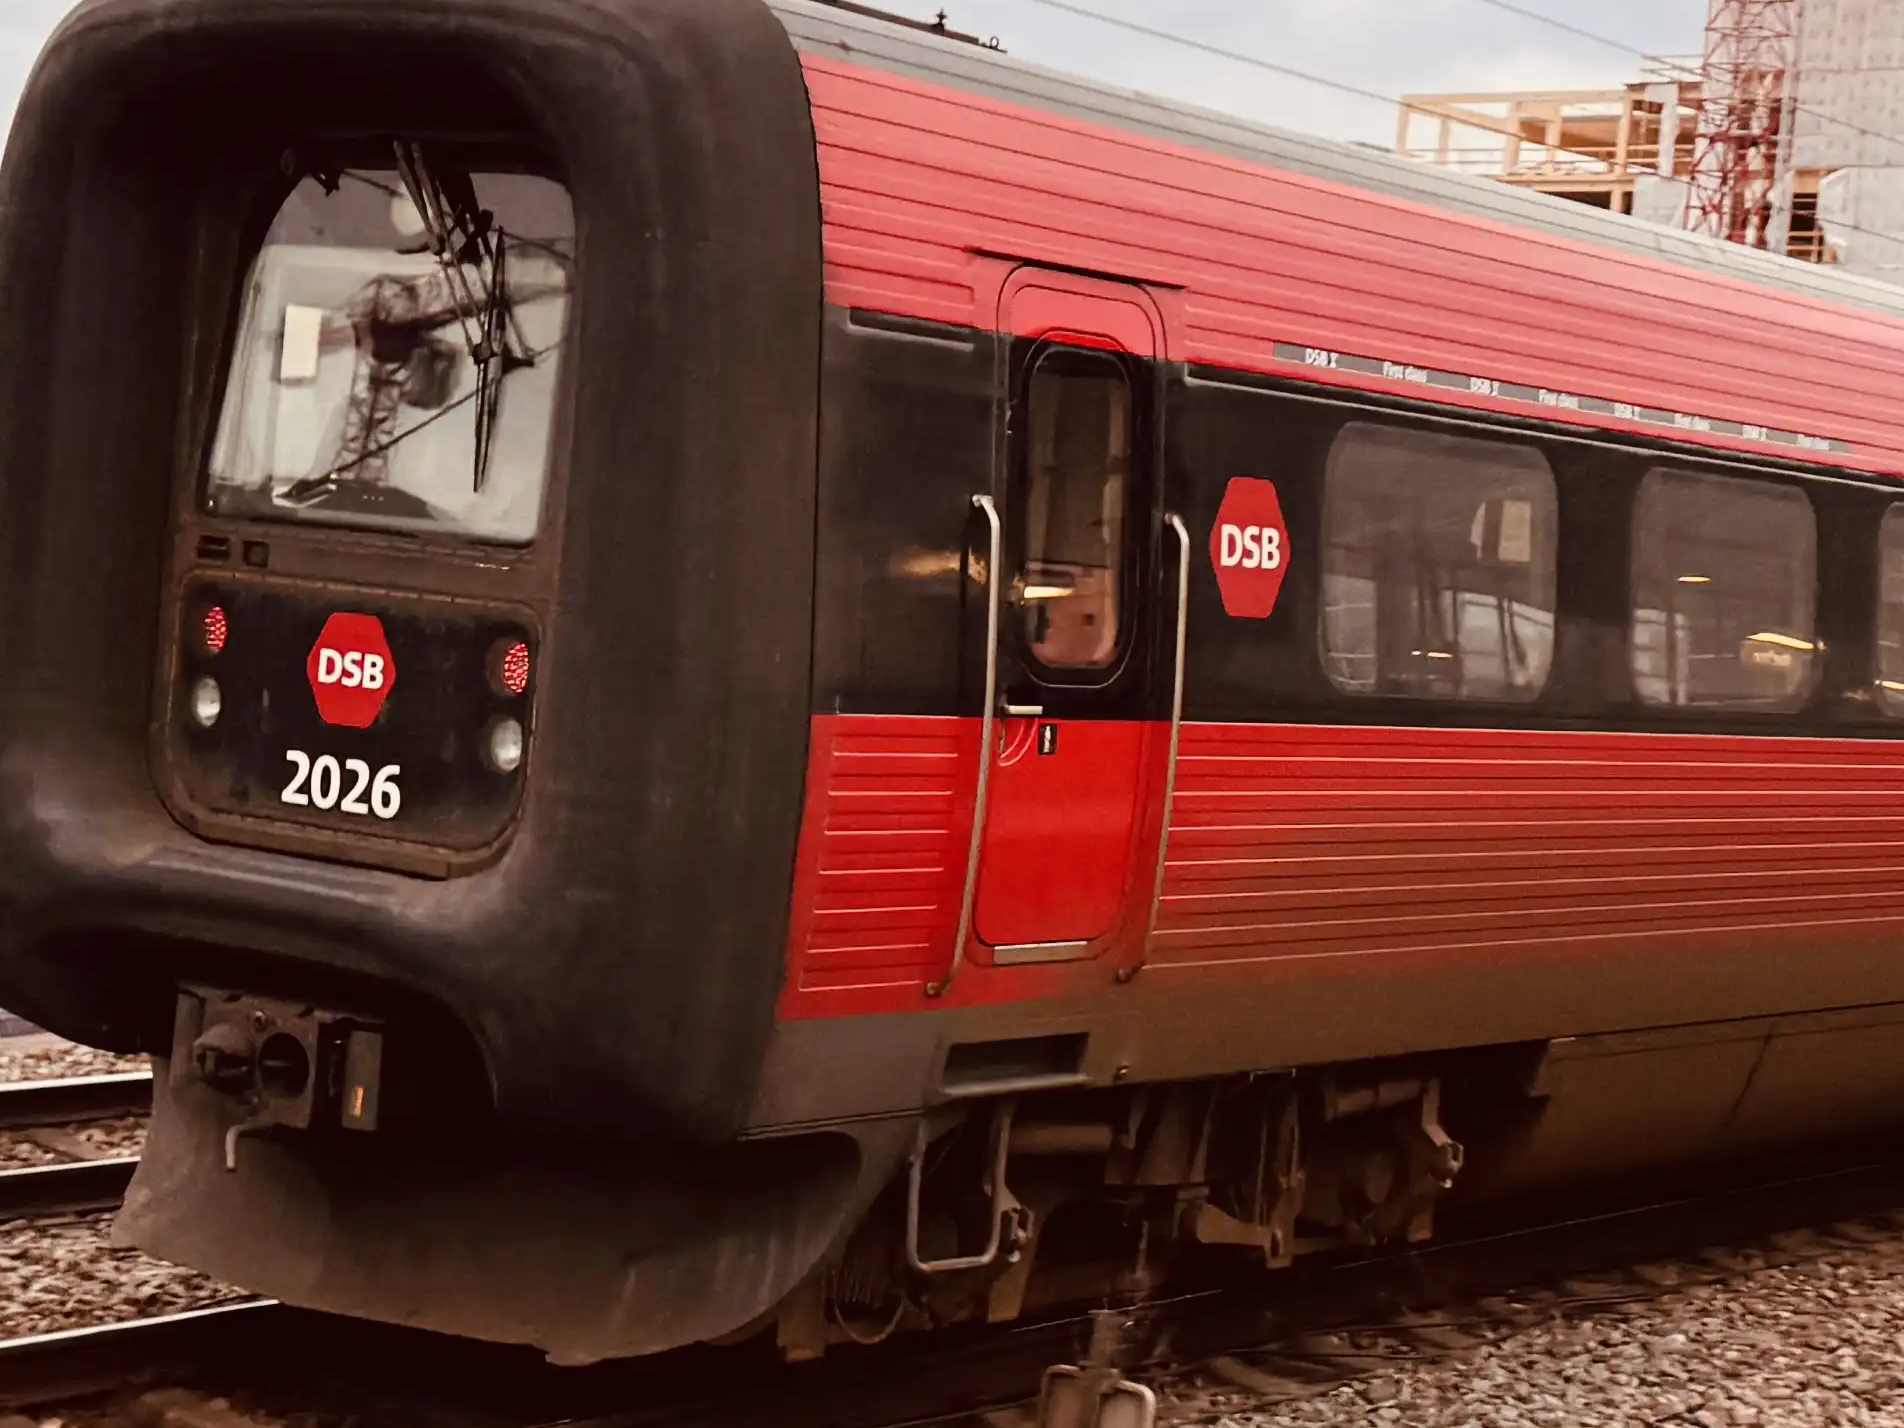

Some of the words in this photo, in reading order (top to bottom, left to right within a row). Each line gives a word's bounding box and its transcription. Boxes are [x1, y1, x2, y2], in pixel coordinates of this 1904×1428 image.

[1220, 523, 1281, 569] DSB
[317, 647, 385, 690] DSB
[281, 749, 401, 820] 2026
